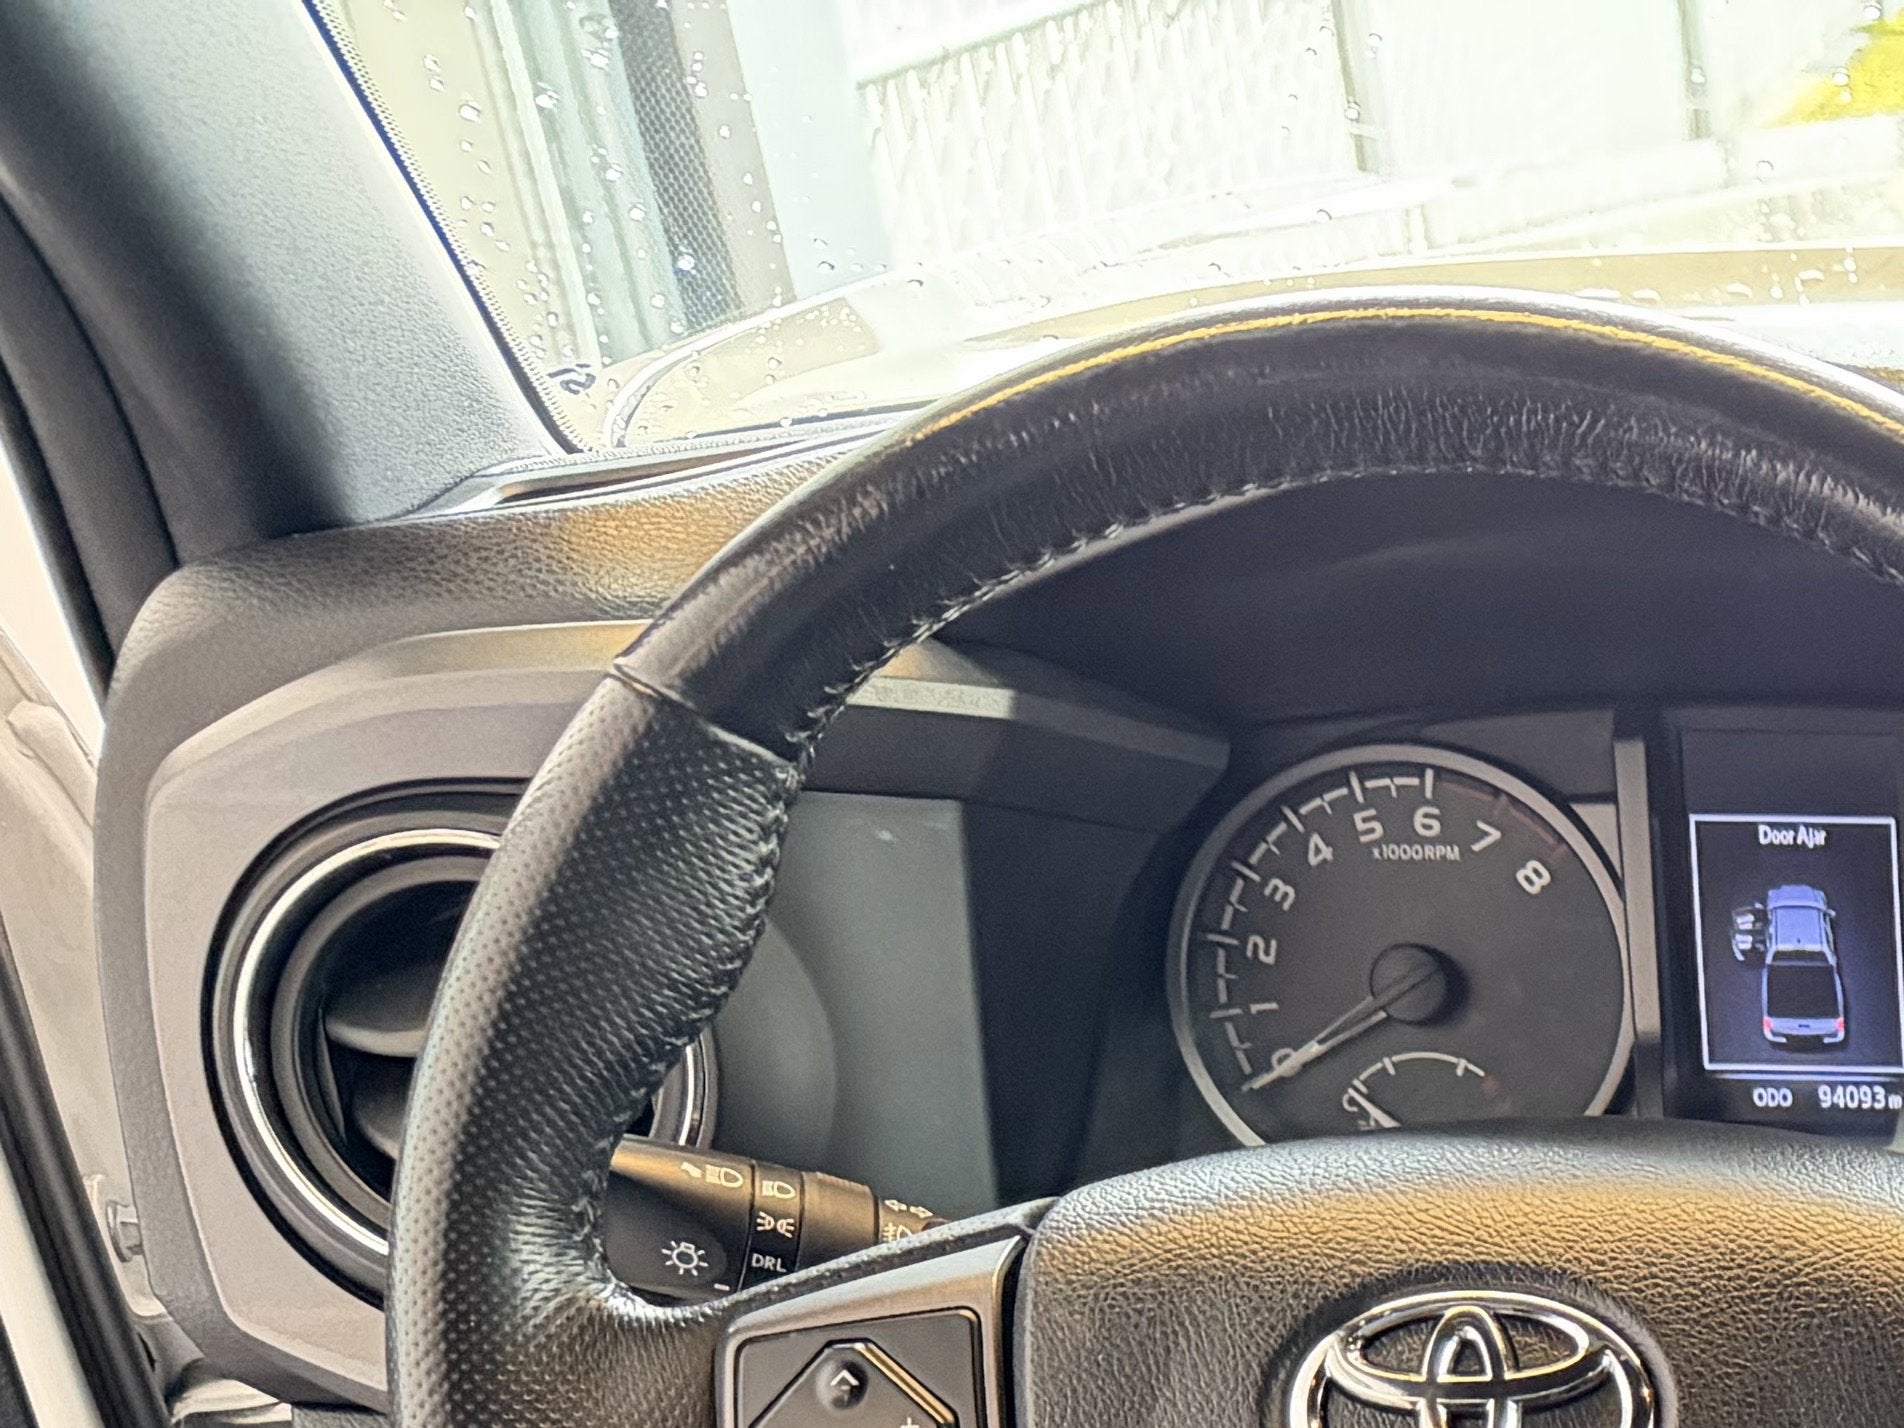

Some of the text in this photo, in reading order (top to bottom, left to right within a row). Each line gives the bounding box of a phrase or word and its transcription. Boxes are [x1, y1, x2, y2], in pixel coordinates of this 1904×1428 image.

[1353, 808, 1384, 843] 5
[1413, 806, 1441, 837] 6
[1471, 820, 1502, 853] 7
[1757, 824, 1795, 846] Door
[1307, 832, 1334, 867] 4
[1515, 859, 1552, 895] 8
[1263, 877, 1297, 912] 3
[1246, 934, 1278, 966] 2
[1249, 1002, 1279, 1016] 1
[1752, 1087, 1794, 1109] ODO
[1817, 1084, 1887, 1111] 94093
[751, 1252, 787, 1273] DRL
